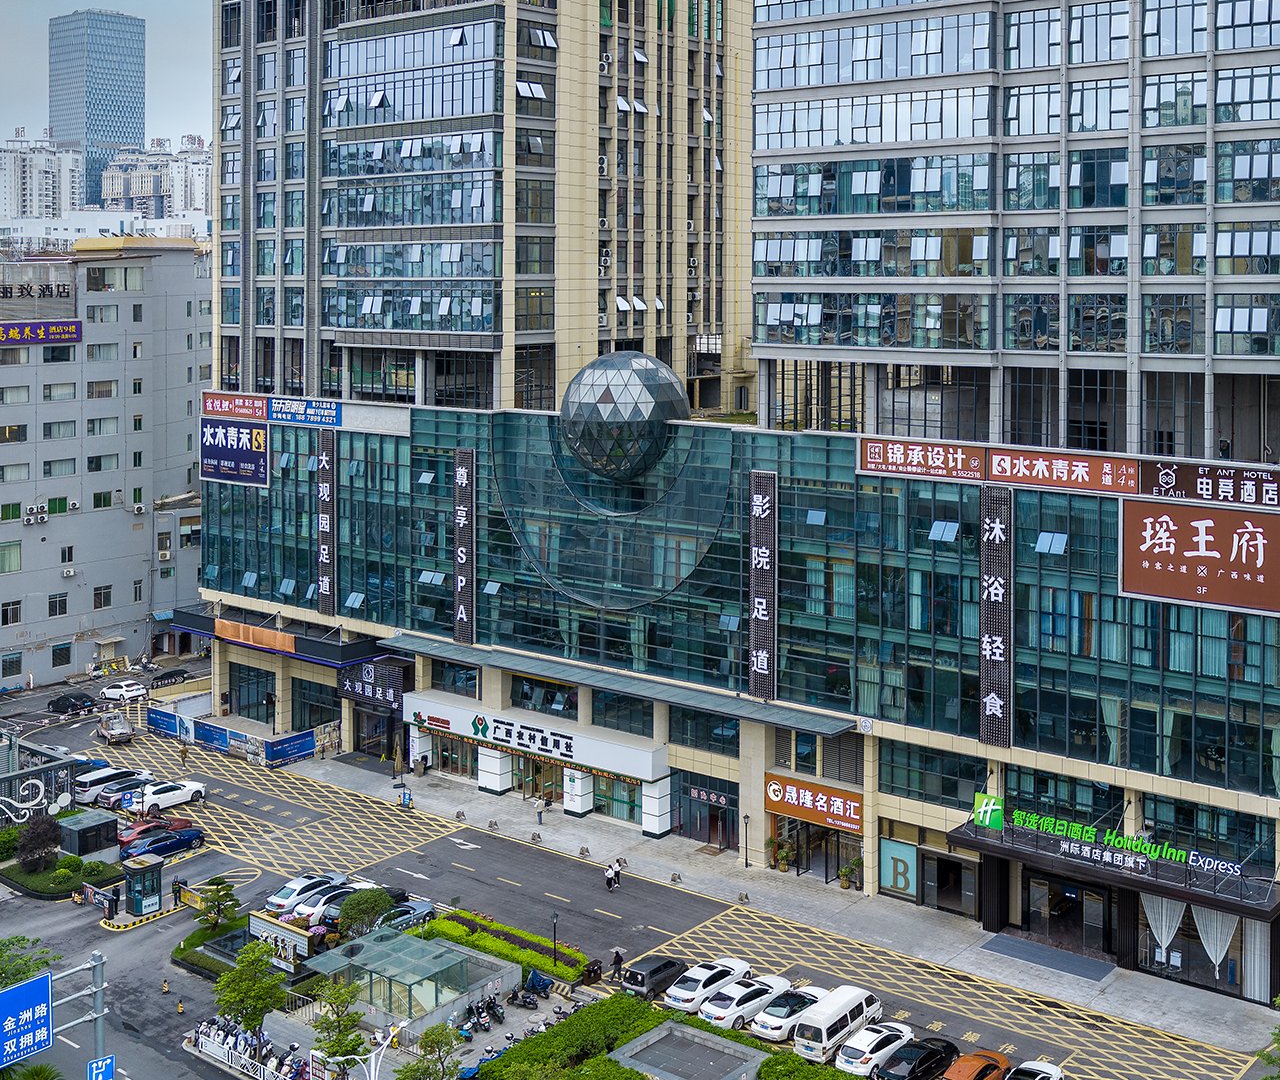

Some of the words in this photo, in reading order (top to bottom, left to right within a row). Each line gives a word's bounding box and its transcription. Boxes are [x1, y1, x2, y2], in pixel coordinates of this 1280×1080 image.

[203, 424, 251, 450] 水木青禾
[886, 443, 966, 469] 锦承设计
[1012, 456, 1089, 482] 水木青禾
[957, 470, 981, 478] 5522518
[1101, 463, 1112, 486] 足道
[1198, 467, 1209, 475] ET
[1217, 469, 1235, 477] ANT
[1243, 470, 1273, 481] HOTEL
[1152, 486, 1167, 496] ET
[1168, 487, 1186, 498] Ant
[1197, 477, 1278, 505] 电竞酒店
[318, 452, 330, 595] 大观园足道
[455, 467, 469, 622] 尊享SPA
[1139, 514, 1268, 568] 瑶王府
[751, 493, 770, 674] 影院足道
[1142, 560, 1188, 573] 待客之道
[1216, 570, 1265, 583] 广西味道
[1196, 586, 1208, 594] 3F
[981, 518, 1006, 717] 沐浴轻食
[344, 679, 395, 701] 大观园足道
[493, 724, 573, 753] 广西农村信用社
[784, 785, 860, 820] 晟隆名酒汇
[1012, 808, 1097, 844] 智选假日酒店
[1060, 841, 1146, 869] 洲际酒店集团旗下
[1104, 829, 1161, 860] Holiday
[1162, 842, 1187, 863] Inn
[1188, 851, 1242, 876] Express
[891, 857, 910, 892] B
[2, 1003, 47, 1032] 金洲路
[7, 1023, 31, 1036] Jinzhou
[3, 1027, 48, 1055] 双拥路
[3, 1046, 37, 1063] Shuangyong
